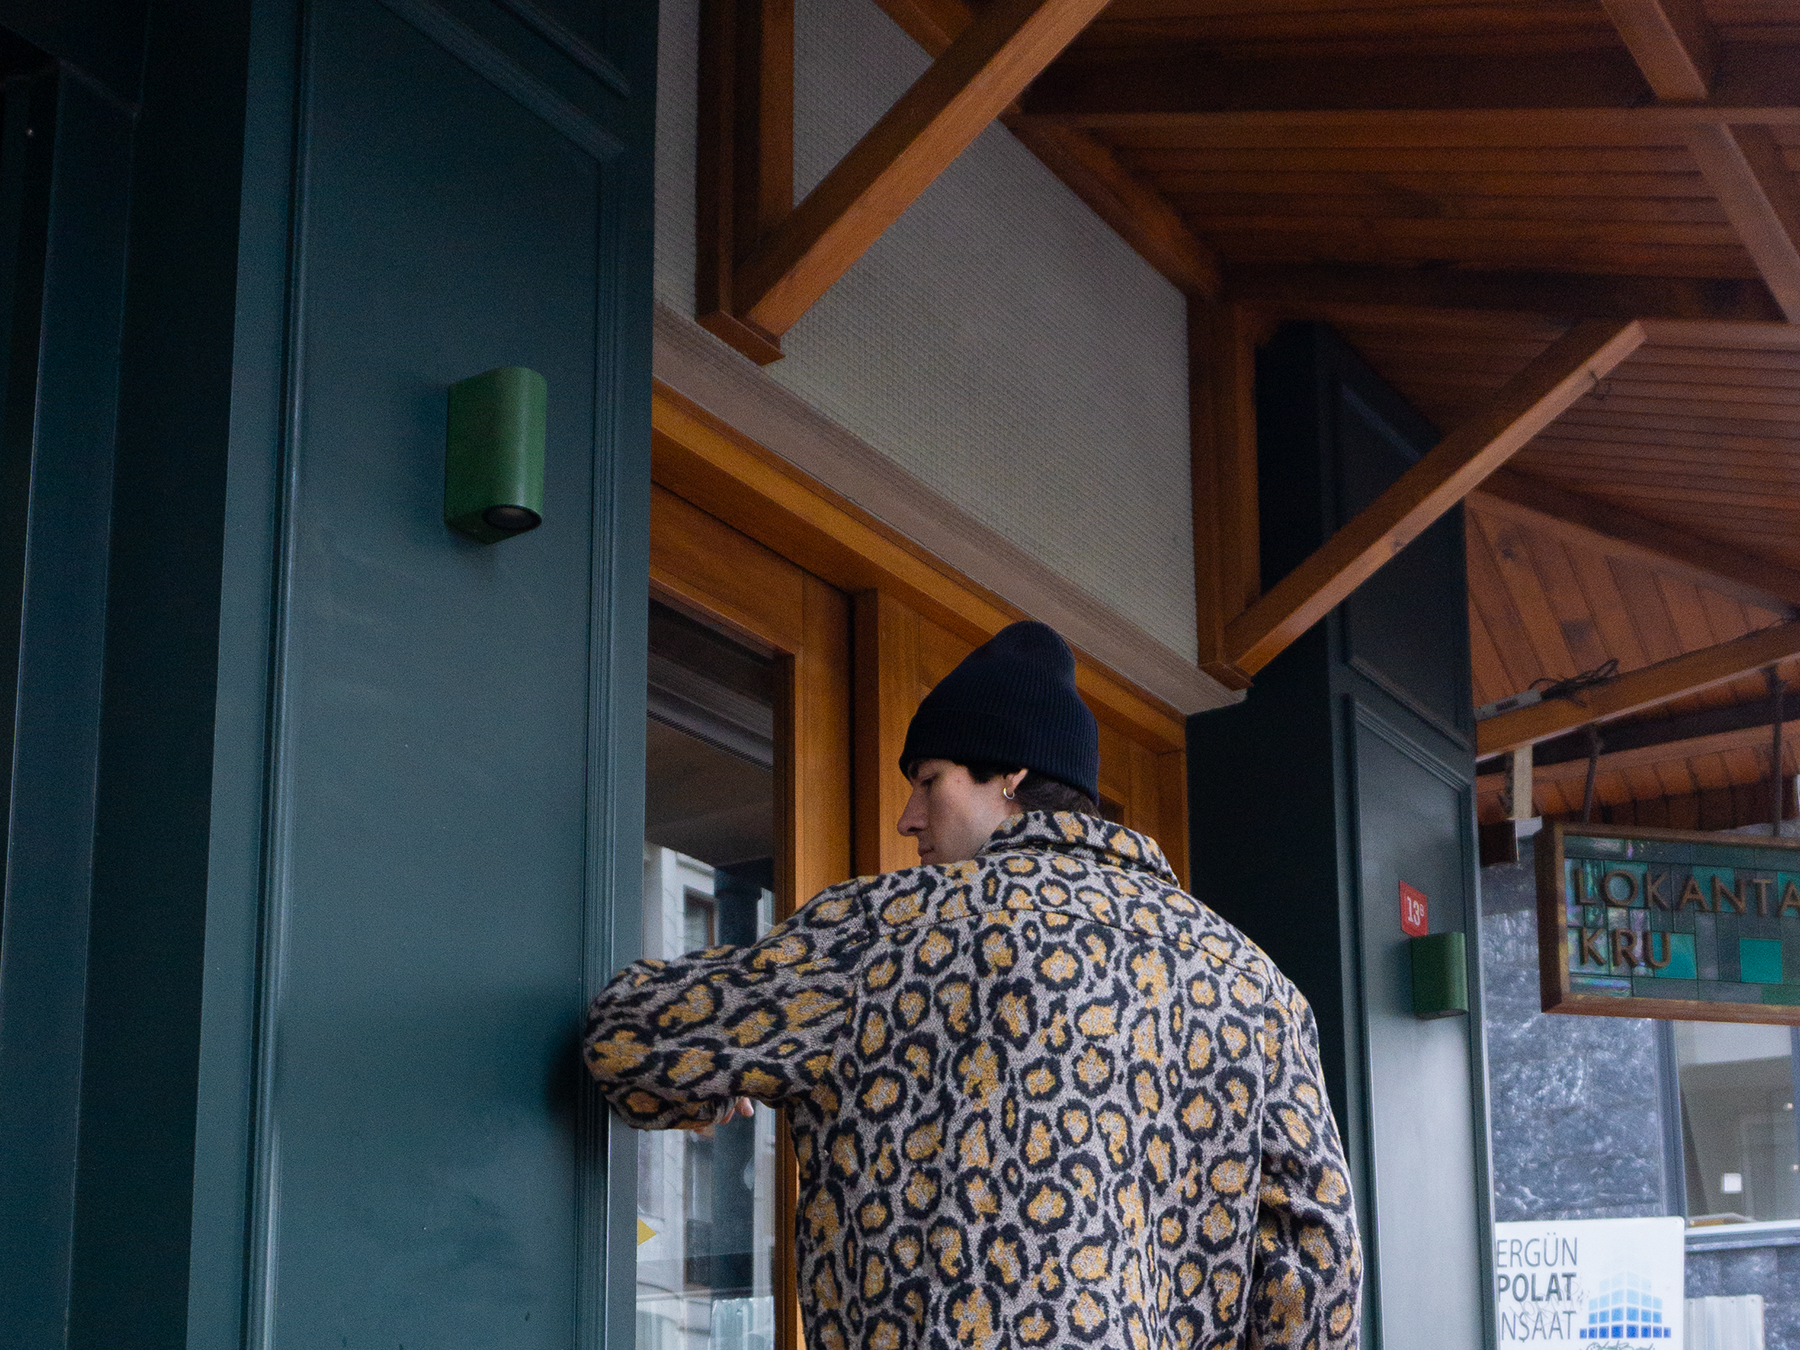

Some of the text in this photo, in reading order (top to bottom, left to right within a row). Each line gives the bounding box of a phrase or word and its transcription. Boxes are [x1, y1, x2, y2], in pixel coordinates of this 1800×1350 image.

[1574, 867, 1800, 918] LOKANTA
[1578, 926, 1671, 970] KRU
[1496, 1232, 1577, 1268] ERGÜN
[1497, 1272, 1577, 1303] POLAT
